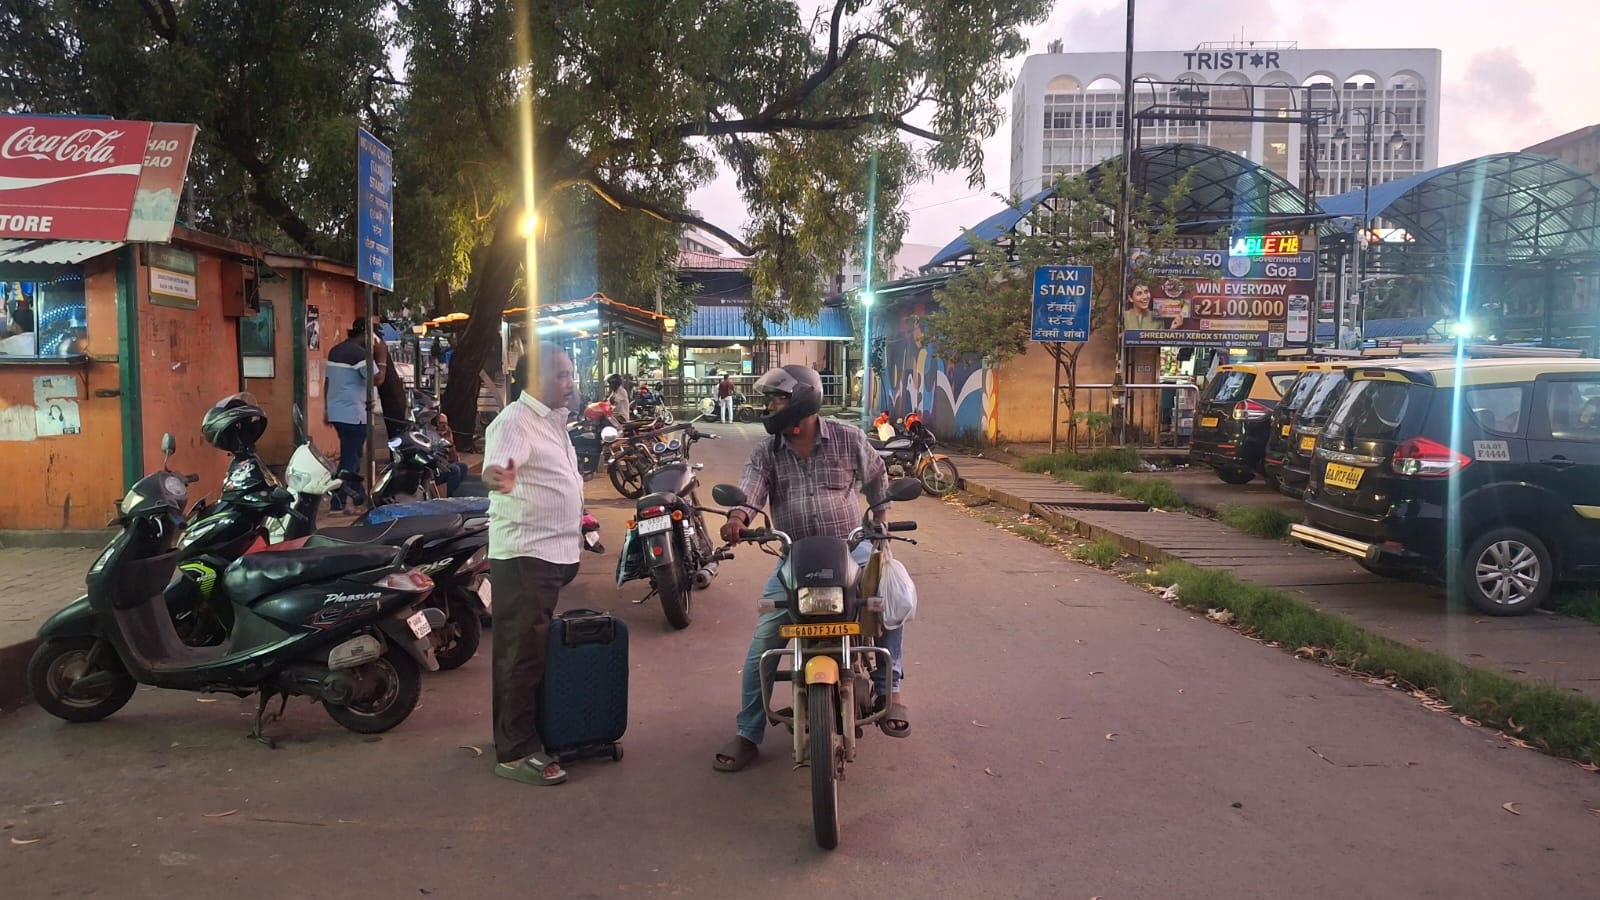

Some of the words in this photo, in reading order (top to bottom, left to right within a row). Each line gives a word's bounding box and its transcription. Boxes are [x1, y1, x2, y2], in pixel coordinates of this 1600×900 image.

[2, 126, 126, 163] Coca-Cola
[1203, 253, 1221, 267] 50
[1252, 255, 1301, 264] Government
[1302, 255, 1312, 264] of
[1048, 270, 1079, 281] TAXI
[1265, 263, 1297, 277] Goa
[1040, 285, 1086, 296] STAND
[1195, 282, 1221, 295] WIN
[1224, 283, 1287, 296] EVERYDAY
[1194, 299, 1284, 318] ₹21,00,000
[1139, 331, 1185, 339] SHREENATH
[1186, 332, 1212, 340] XEROX
[1213, 333, 1260, 341] STATIONERY
[323, 592, 382, 606] Pleasure
[795, 625, 850, 636] GA07F3415
